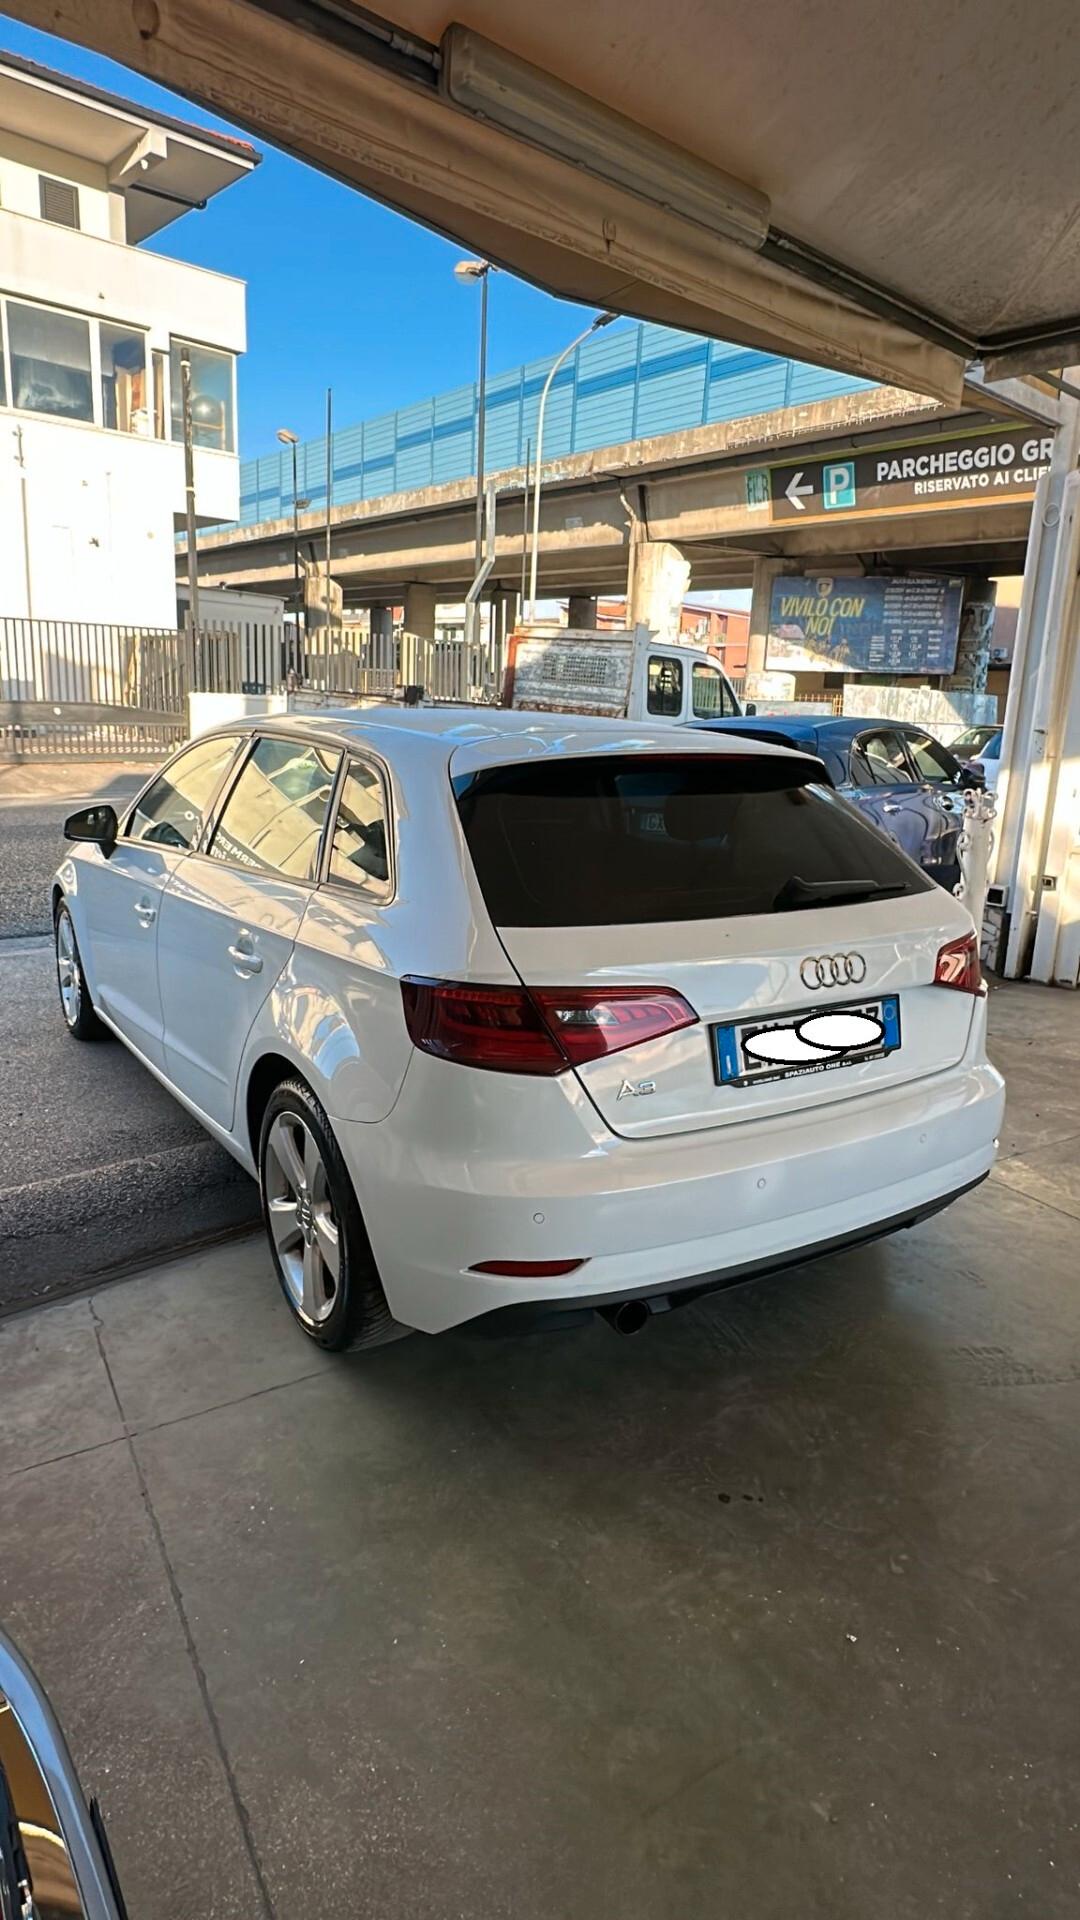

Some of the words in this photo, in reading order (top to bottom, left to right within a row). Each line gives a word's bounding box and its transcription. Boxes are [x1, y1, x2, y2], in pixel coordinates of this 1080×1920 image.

[876, 443, 1015, 482] PARCHEGGIO
[829, 467, 850, 505] P
[914, 473, 990, 495] RISERVATO
[993, 471, 1010, 486] AI
[1013, 466, 1052, 483] CLIE
[781, 596, 829, 617] VIVILO
[829, 598, 865, 618] CON
[805, 616, 836, 636] NOI
[784, 1064, 825, 1079] SPAZIAUTO
[826, 1061, 841, 1070] ONE
[616, 1079, 656, 1101] A3
